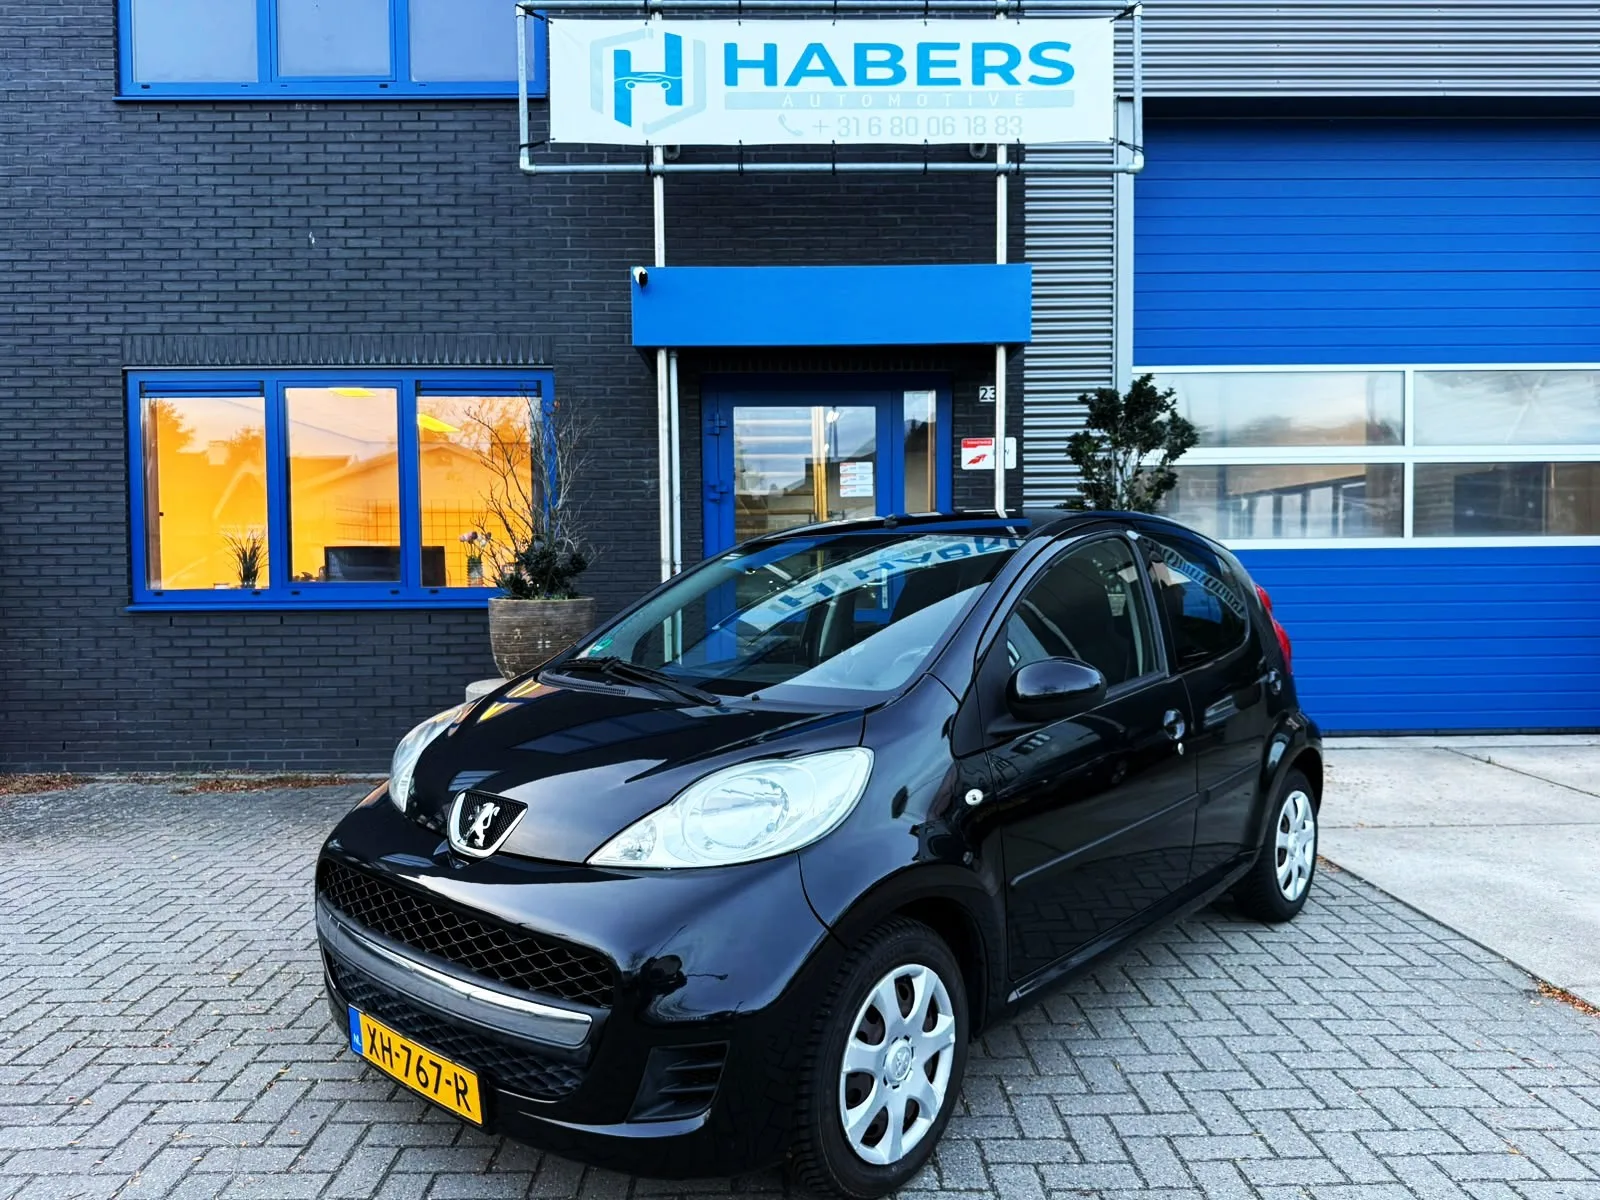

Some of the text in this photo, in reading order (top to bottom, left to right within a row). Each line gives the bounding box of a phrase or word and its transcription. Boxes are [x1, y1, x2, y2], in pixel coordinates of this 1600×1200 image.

[724, 41, 1075, 86] HABERS
[782, 94, 1024, 108] AUTOMOTIVE
[890, 116, 919, 137] 80
[927, 116, 955, 137] 06
[964, 116, 987, 137] 18
[995, 115, 1023, 136] 83
[980, 387, 996, 400] 23
[353, 1032, 362, 1047] NL
[366, 1023, 472, 1112] XH-767-R
